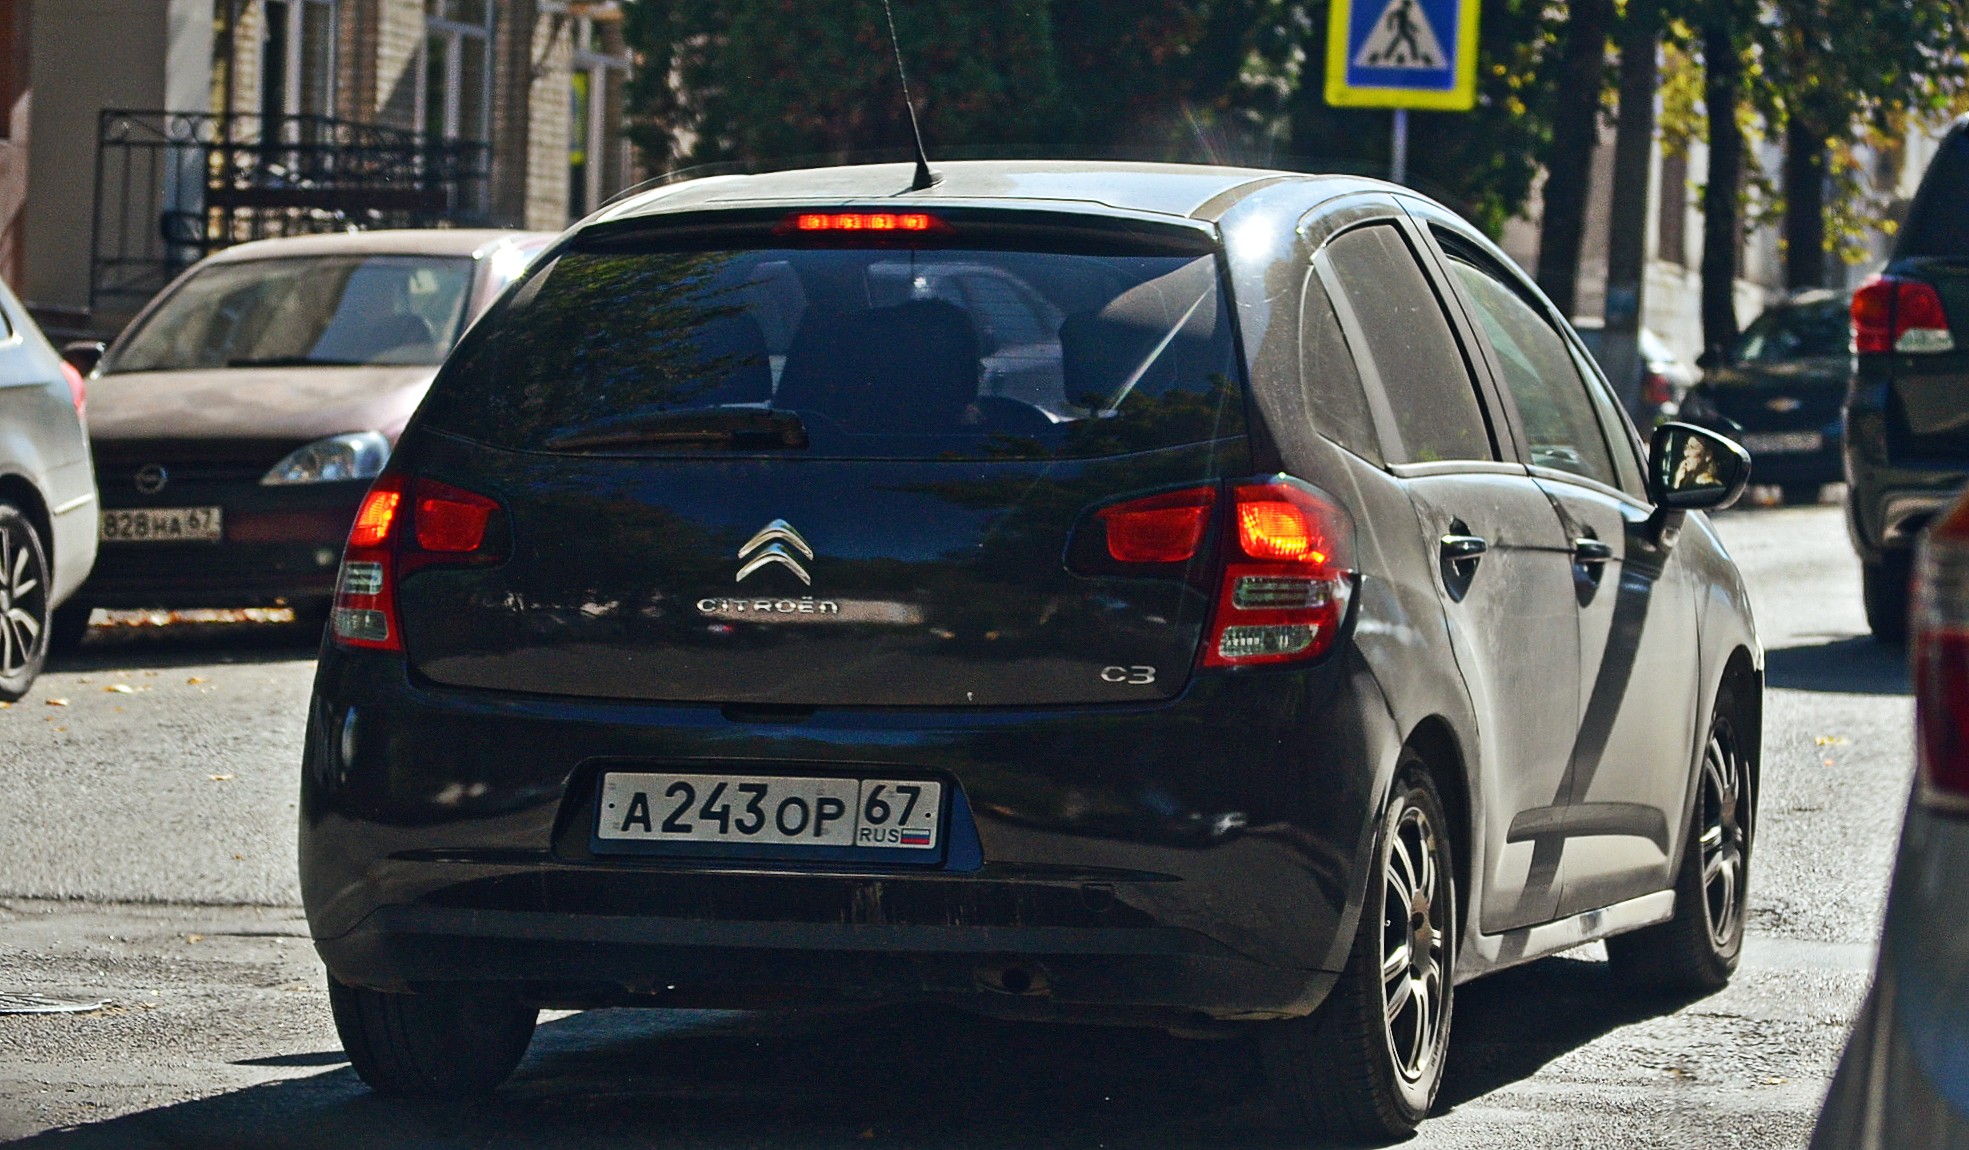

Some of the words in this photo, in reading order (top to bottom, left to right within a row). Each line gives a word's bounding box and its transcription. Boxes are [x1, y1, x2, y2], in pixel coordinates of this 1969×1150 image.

[103, 511, 182, 537] 828НА
[1101, 666, 1156, 684] C3
[863, 785, 921, 826] 67
[860, 828, 900, 843] RUS
